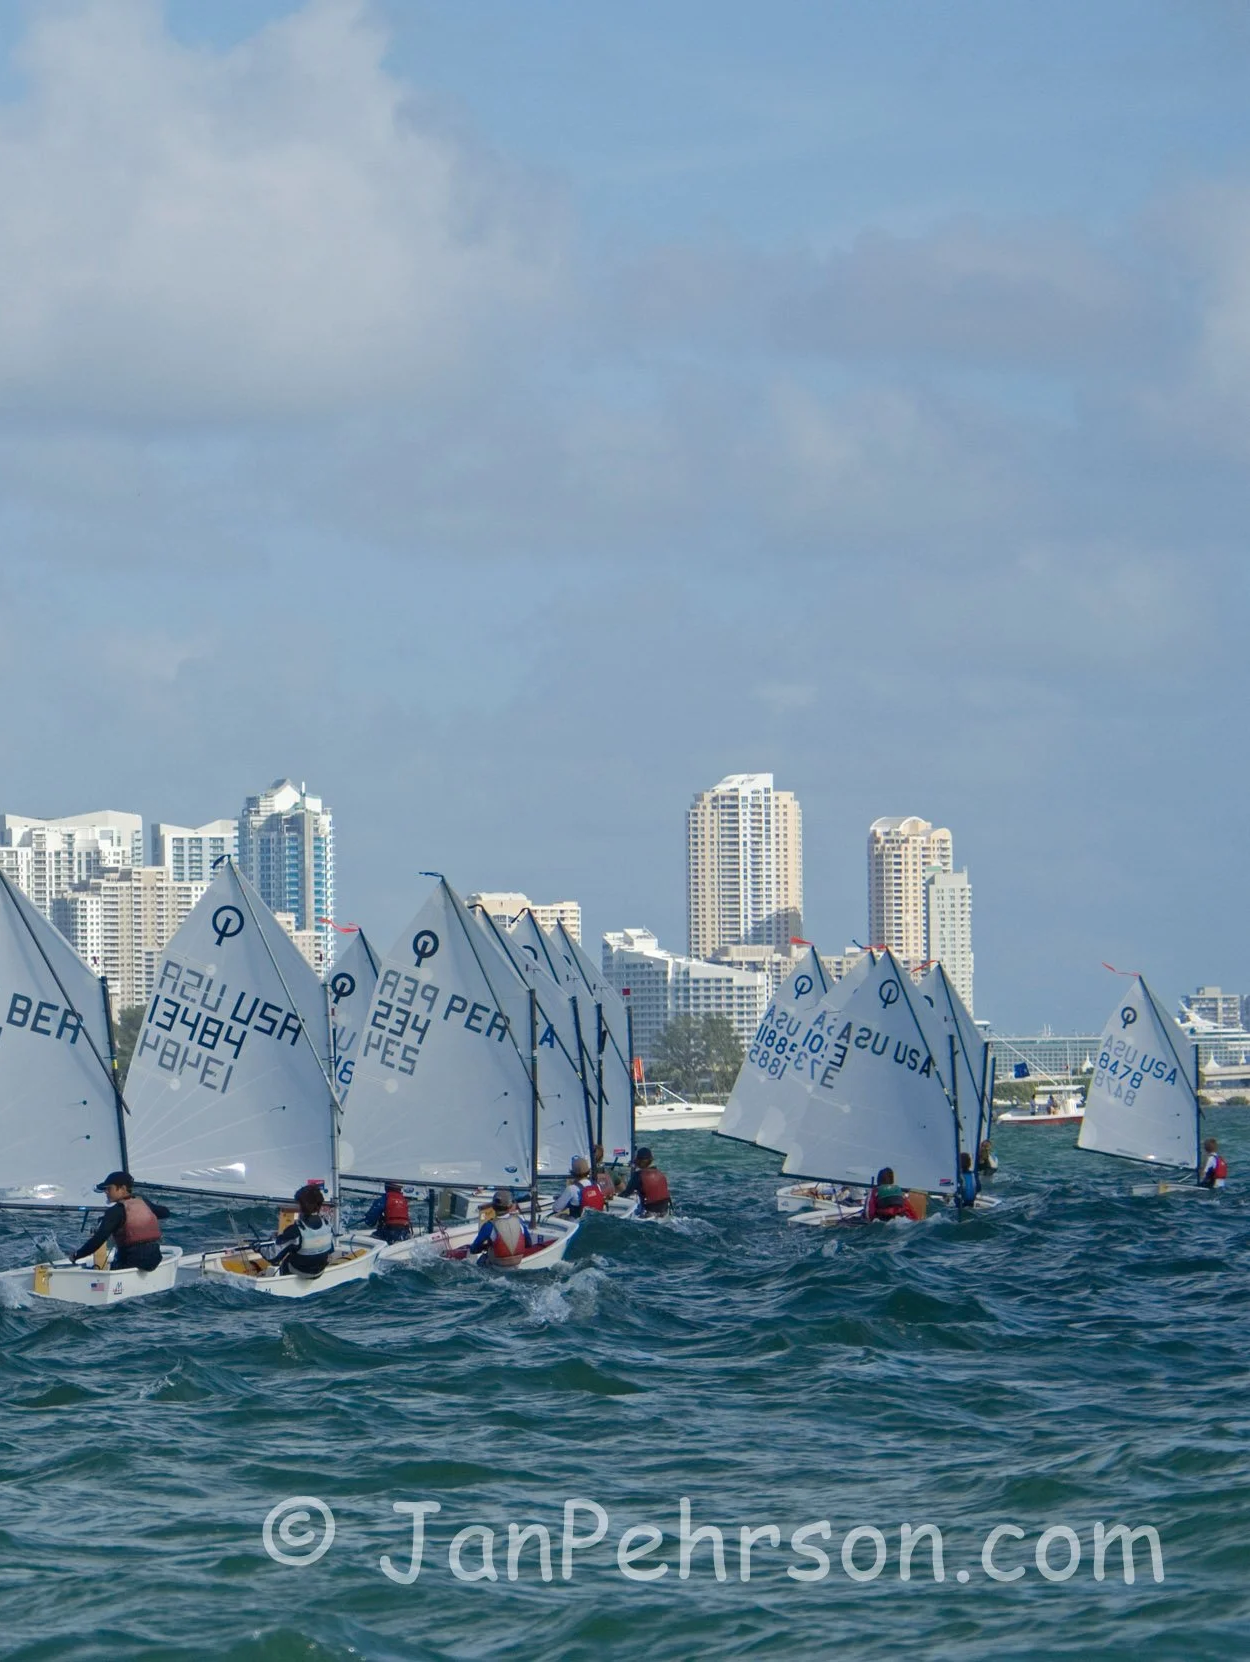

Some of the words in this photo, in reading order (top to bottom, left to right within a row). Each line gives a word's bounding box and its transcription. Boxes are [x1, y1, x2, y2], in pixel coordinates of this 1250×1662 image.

[6, 992, 84, 1045] BER
[147, 994, 248, 1060] 13484
[230, 991, 306, 1047] USA
[371, 1000, 431, 1045] 234
[443, 993, 511, 1043] PER
[893, 1041, 932, 1078] USA
[1099, 1051, 1144, 1089] 8478
[1140, 1053, 1178, 1086] USA
